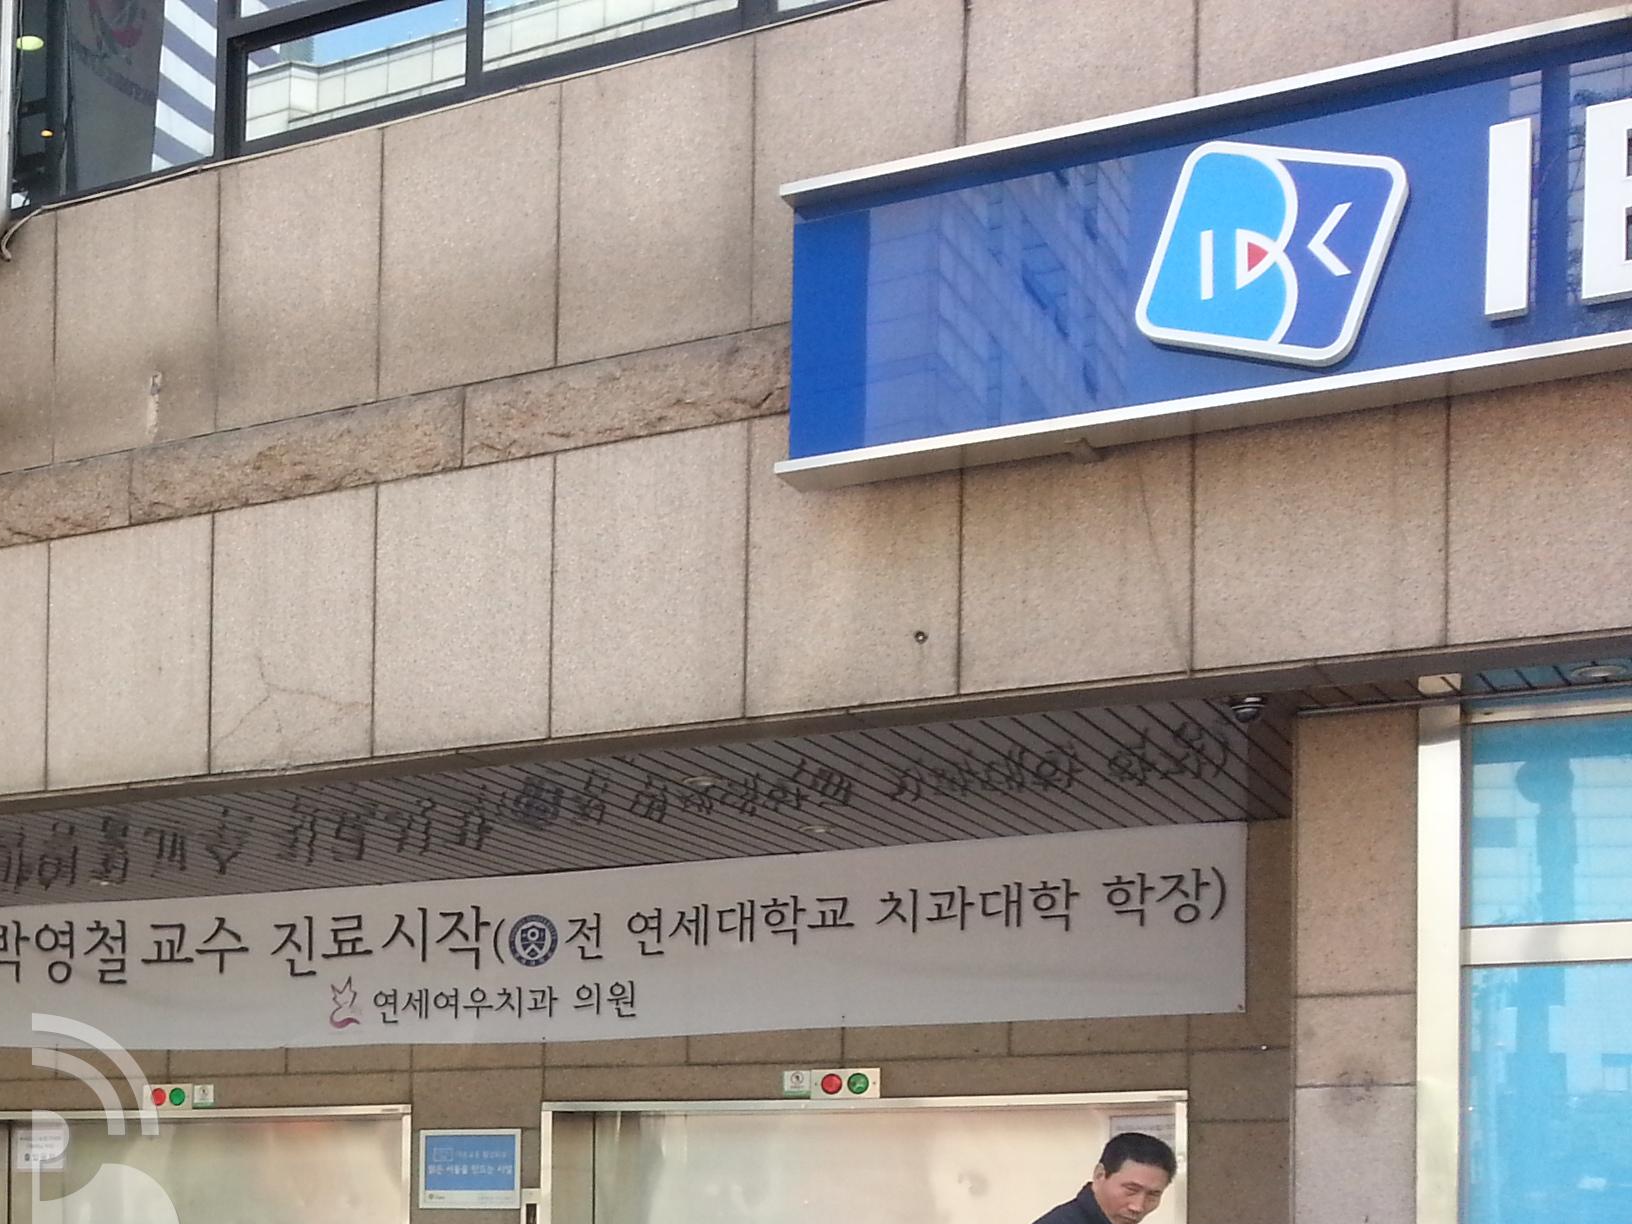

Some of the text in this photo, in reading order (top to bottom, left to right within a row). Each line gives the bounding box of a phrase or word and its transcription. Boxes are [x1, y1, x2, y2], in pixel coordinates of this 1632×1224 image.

[626, 893, 856, 958] 연세대학교
[875, 876, 1081, 934] 치과대학
[1101, 863, 1230, 927] 학장)
[373, 980, 638, 1022] 연세여우치과 의원
